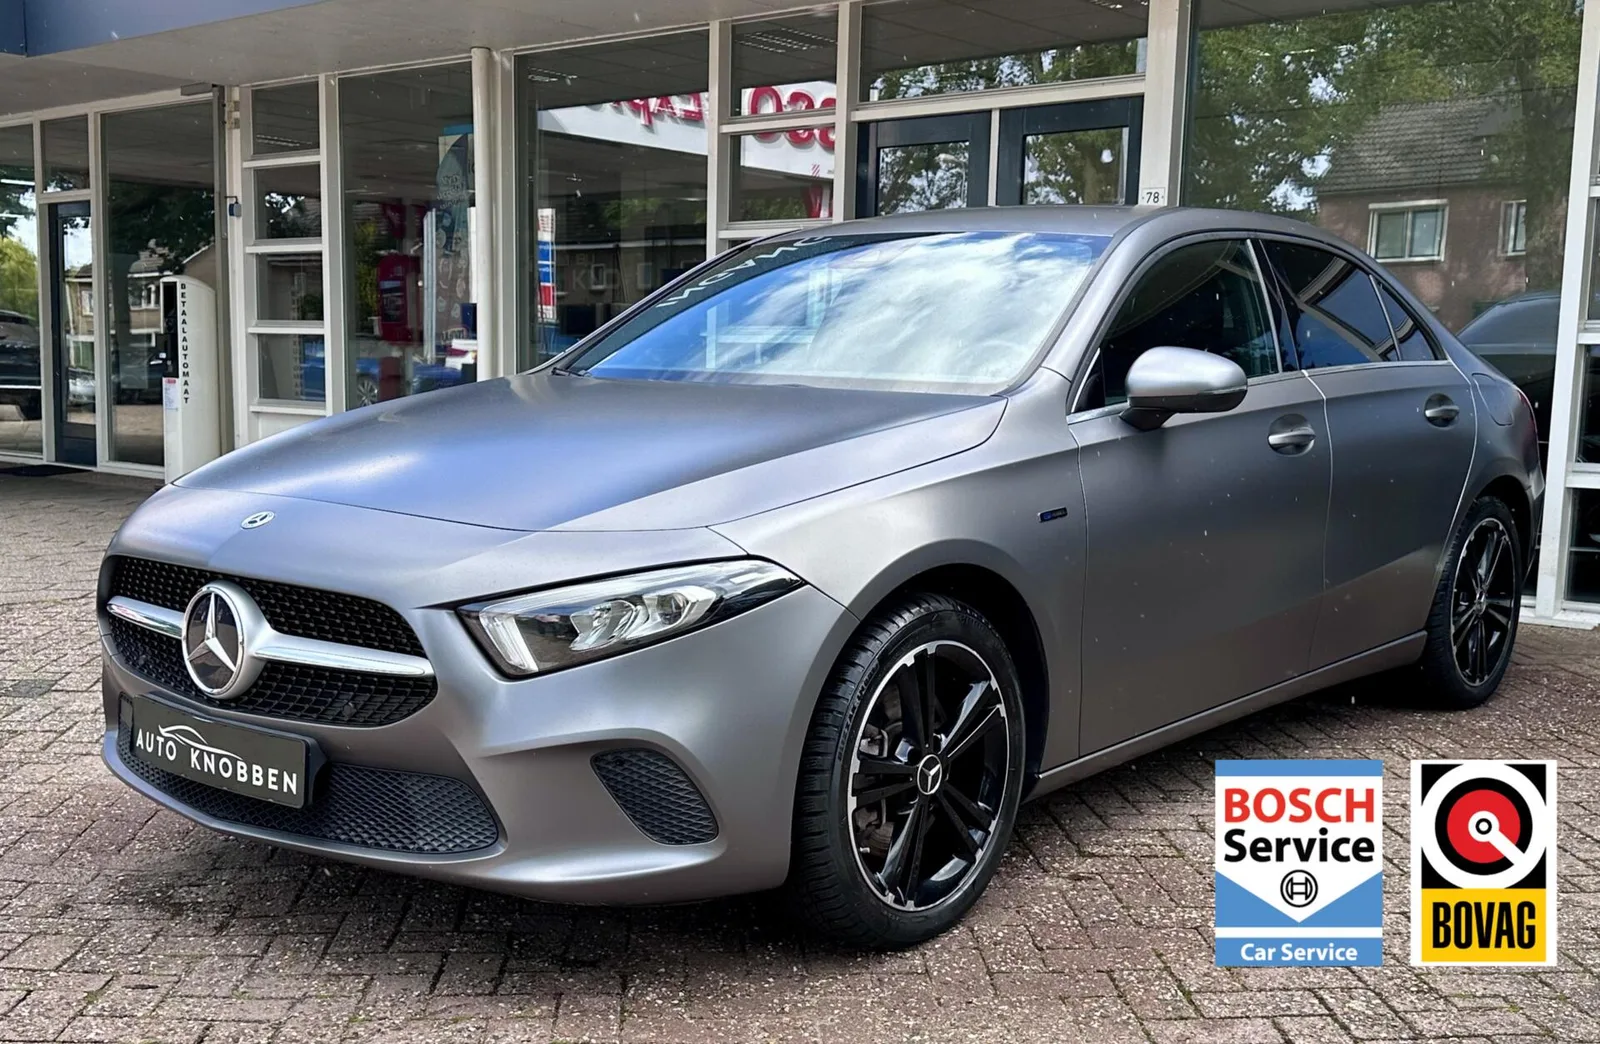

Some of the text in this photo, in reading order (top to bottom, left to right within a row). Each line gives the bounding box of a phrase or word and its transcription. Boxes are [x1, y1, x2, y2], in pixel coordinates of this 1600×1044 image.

[1146, 191, 1160, 204] 78
[180, 283, 190, 404] BETAALAUTOMAAT
[136, 728, 298, 796] AUTO KNOBBEN
